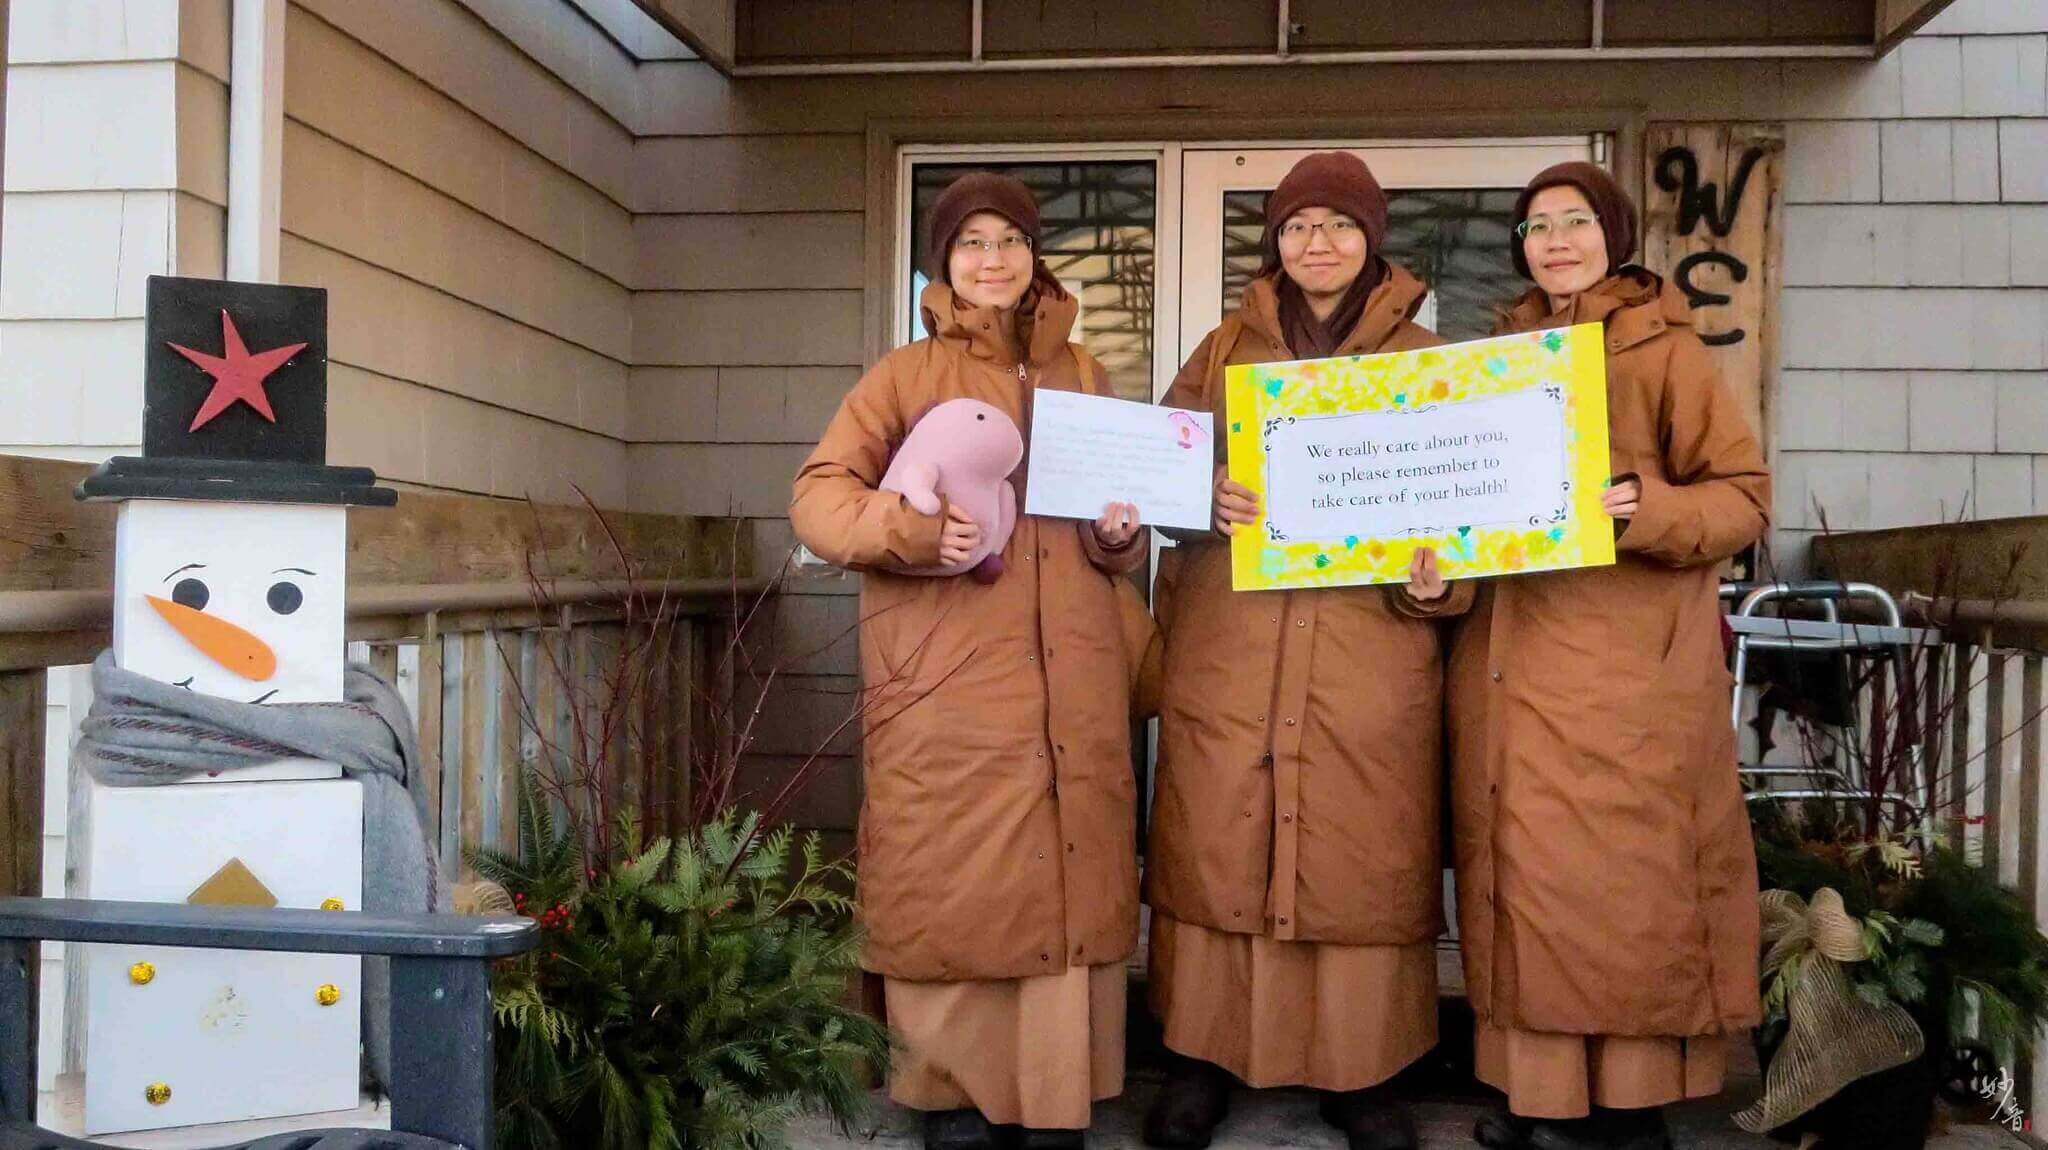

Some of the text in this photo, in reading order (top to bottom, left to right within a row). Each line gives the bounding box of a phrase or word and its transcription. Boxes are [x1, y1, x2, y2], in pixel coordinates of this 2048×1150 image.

[1306, 430, 1509, 460] We really care about you,
[1317, 457, 1500, 487] so please remember to
[1311, 478, 1509, 510] take care of your health!
